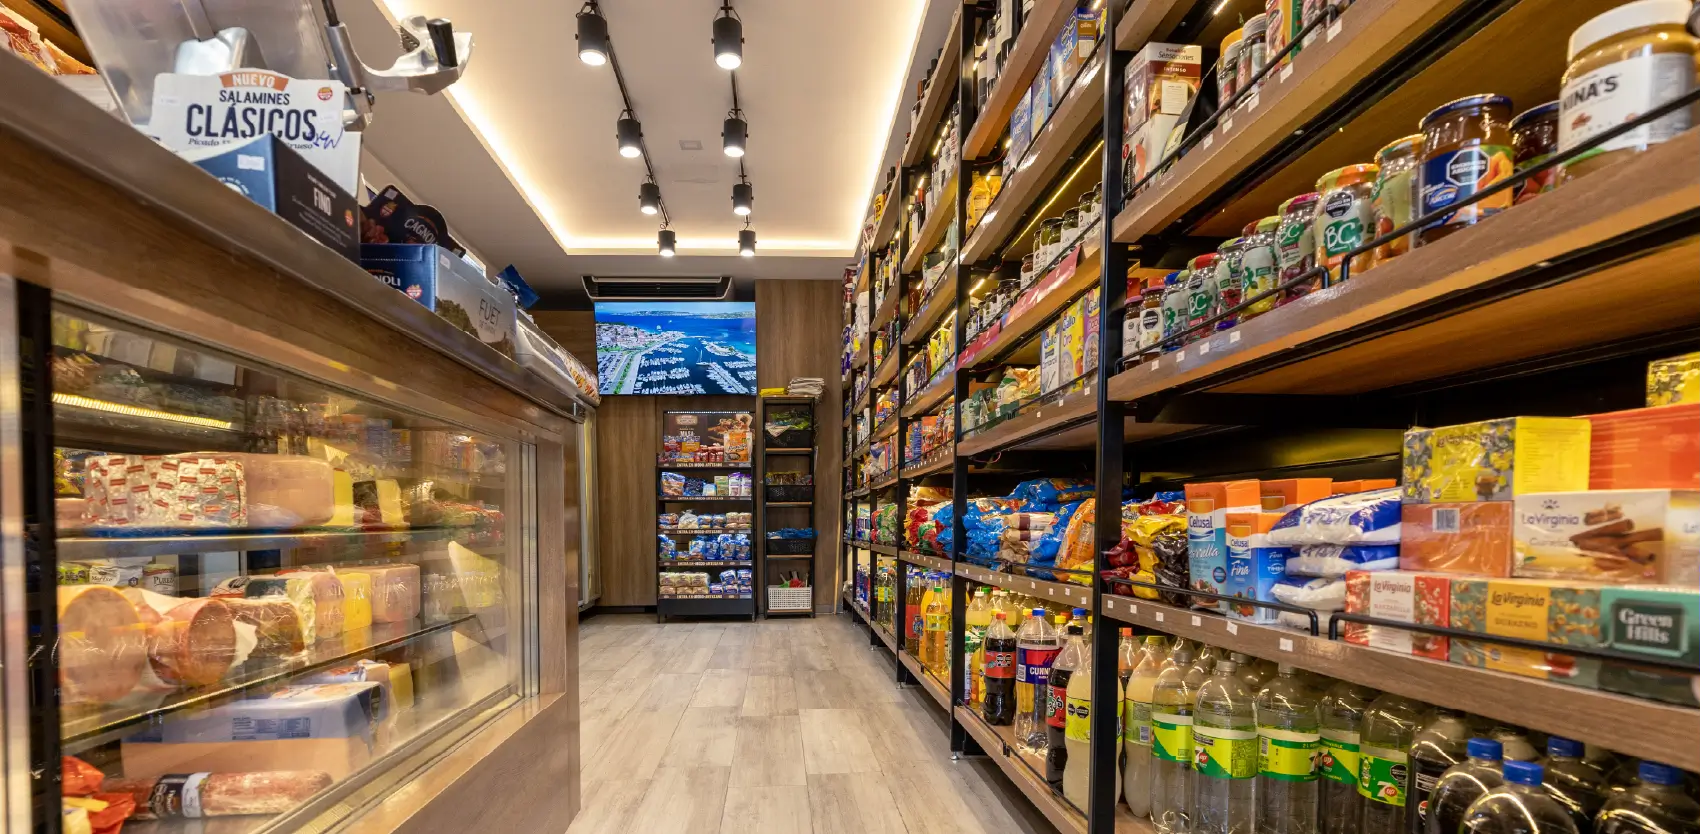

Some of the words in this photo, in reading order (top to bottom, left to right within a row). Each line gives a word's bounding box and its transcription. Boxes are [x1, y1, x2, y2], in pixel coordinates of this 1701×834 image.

[232, 73, 275, 88] NUEVO
[219, 90, 290, 106] SALAMINES
[186, 102, 318, 141] CLÁSICOS
[188, 137, 220, 147] Picado
[288, 141, 313, 150] rueso
[313, 186, 332, 216] FINO
[404, 217, 437, 244] CAGNOL
[1325, 222, 1356, 249] BC
[374, 274, 401, 287] NOLI
[478, 297, 501, 327] FUET
[1189, 515, 1213, 529] Celusal
[1231, 539, 1250, 548] Celusal
[1230, 559, 1251, 577] Fina
[1618, 607, 1674, 629] Green
[1626, 625, 1671, 645] Hills
[1029, 666, 1051, 676] CUNN
